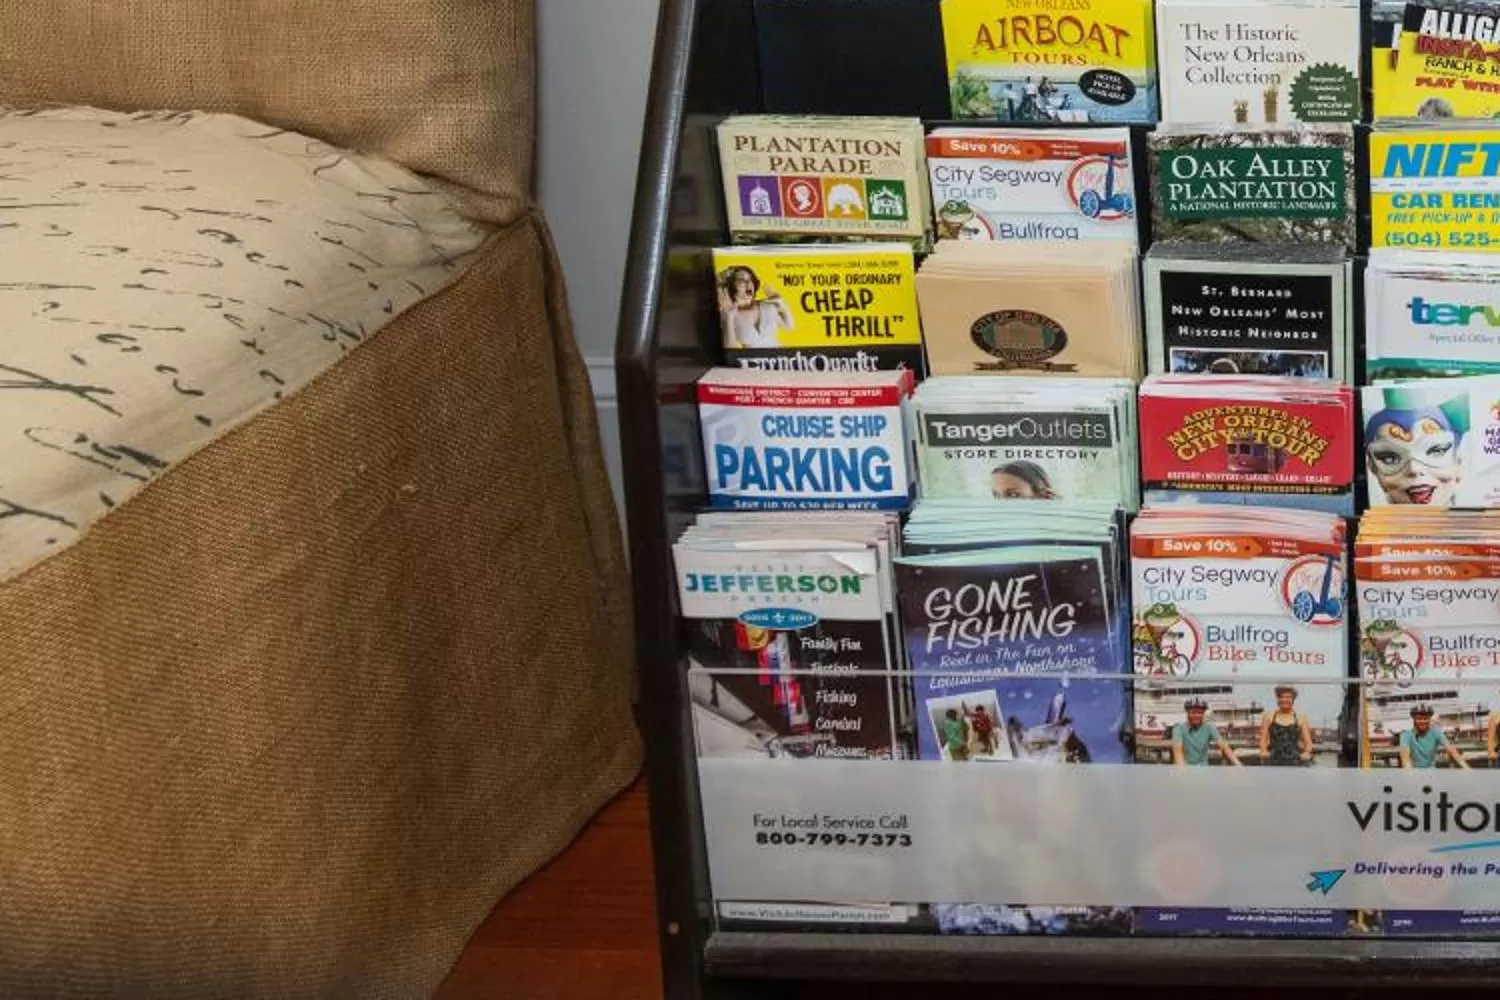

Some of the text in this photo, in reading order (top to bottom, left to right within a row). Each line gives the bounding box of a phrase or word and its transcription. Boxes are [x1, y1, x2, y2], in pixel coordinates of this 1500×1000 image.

[974, 14, 1132, 59] AIRBOAT
[1179, 22, 1299, 43] The Historic
[1008, 51, 1087, 66] TOURS
[1184, 44, 1306, 64] New Orleans
[1185, 67, 1281, 87] Collection
[733, 134, 902, 158] PLANTATION
[768, 154, 874, 176] PARADE
[1170, 152, 1333, 180] OAK ALLEY
[1168, 180, 1337, 202] PLANTATION
[1383, 230, 1442, 248] (504)
[811, 272, 903, 286] YOUR ORDINARY
[800, 290, 874, 314] CHEAP
[761, 415, 887, 439] CRUISE SHIP
[930, 417, 1107, 442] TangerOutlets
[944, 450, 1100, 462] STORE DIRECTORY
[714, 443, 893, 493] PARKING
[686, 573, 862, 595] JEFFERSON
[925, 575, 1037, 621] GONE
[926, 602, 1076, 654] FISHING
[1206, 625, 1290, 648] Bullfrog
[1206, 645, 1327, 666] Bike Tours
[753, 814, 909, 829] For Local Service Call
[755, 831, 913, 847] 800-799-7373
[1354, 861, 1444, 879] Delivering
[1449, 861, 1479, 877] the
